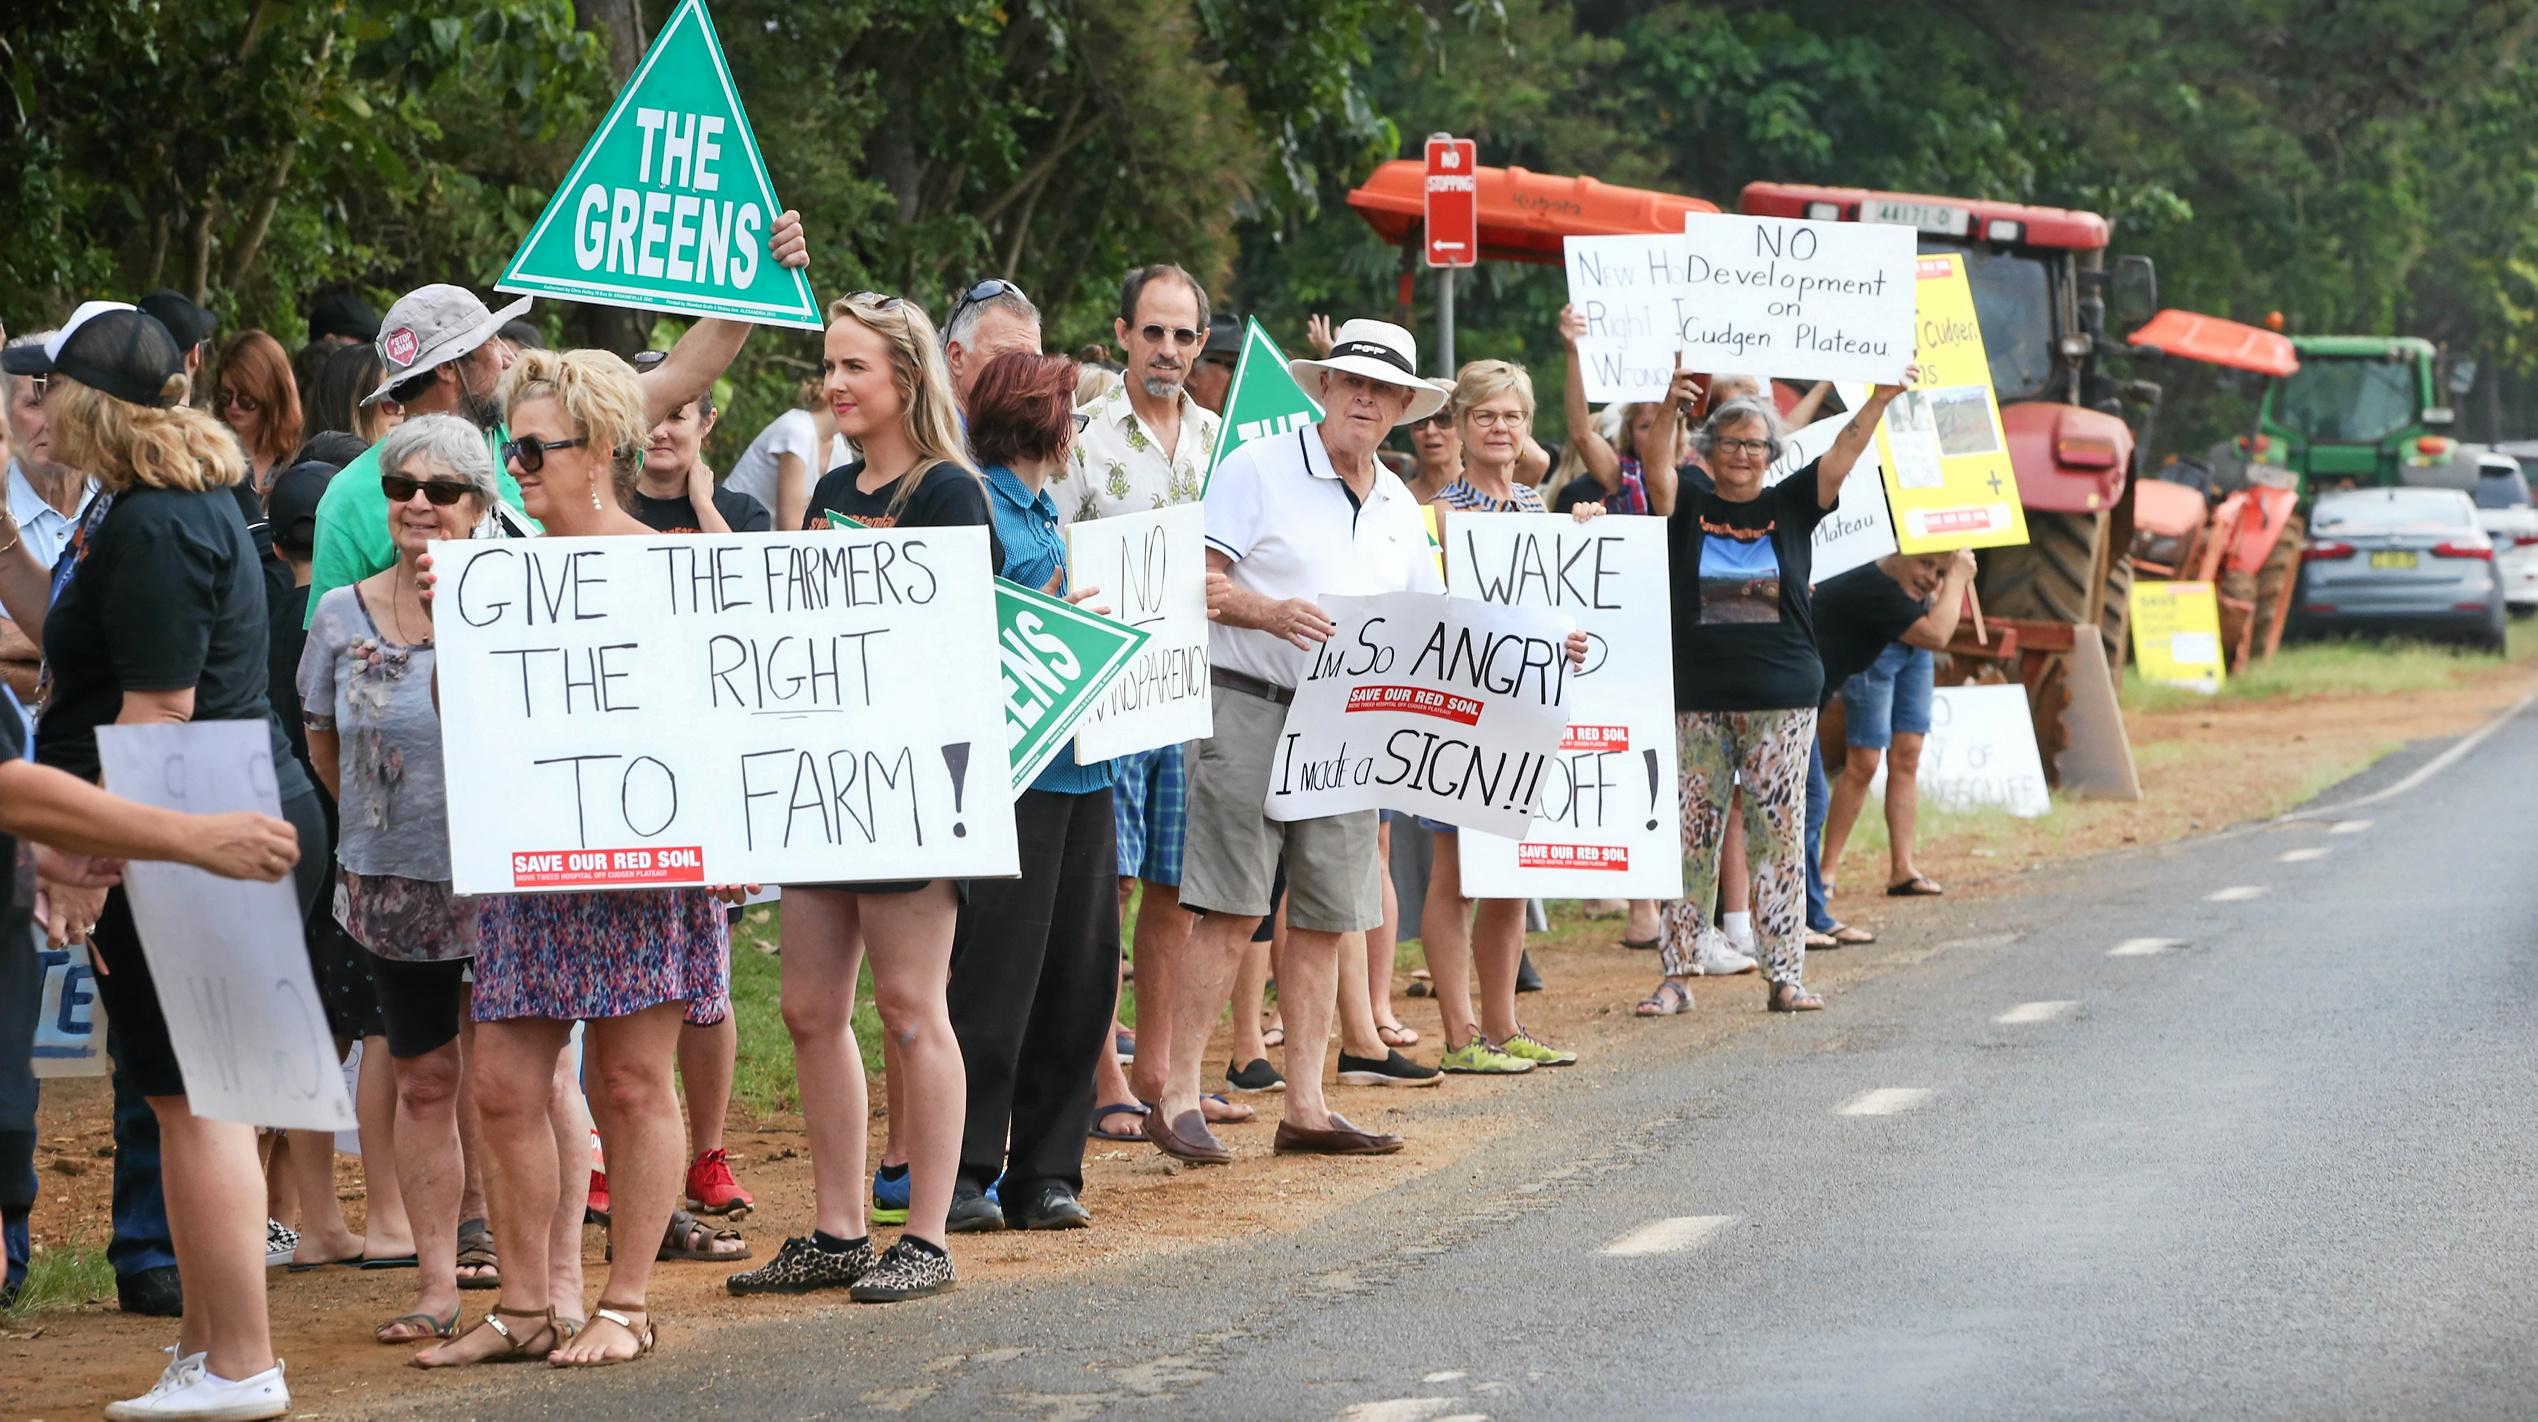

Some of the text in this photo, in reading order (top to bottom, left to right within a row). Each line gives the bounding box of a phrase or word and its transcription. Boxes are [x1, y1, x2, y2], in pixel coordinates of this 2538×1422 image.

[635, 108, 725, 192] THE
[1441, 152, 1460, 168] NO
[1427, 175, 1473, 192] STOPPING
[574, 183, 761, 290] GREENS
[1757, 225, 1816, 260] NO
[1688, 254, 1886, 300] Development
[1768, 302, 1801, 317] on
[394, 341, 414, 357] ADANI
[1683, 317, 1770, 356] Cudgen
[1796, 324, 1890, 356] Plateau.
[458, 540, 936, 627] GIVE THE FARMERS
[1122, 525, 1166, 619] NO
[1467, 529, 1625, 609] WAKE
[489, 629, 890, 718] THE RIGHT
[1347, 617, 1394, 676] So
[1411, 621, 1567, 706] ANGRY
[1350, 688, 1479, 716] SAVE OUR RED SOIL
[1577, 728, 1600, 740] RED
[1602, 728, 1628, 741] SOIL
[1275, 732, 1301, 795] I
[1354, 757, 1375, 785] a
[1375, 729, 1545, 815] SIGN!!
[533, 755, 677, 849] TO
[514, 849, 700, 873] SAVE OUR RED SOIL
[1520, 845, 1628, 862] SAVE OUR RED SOIL
[536, 872, 560, 881] TWEED
[560, 872, 593, 880] HOSPITAL
[594, 871, 607, 879] OFF
[608, 870, 635, 879] CUDGEN
